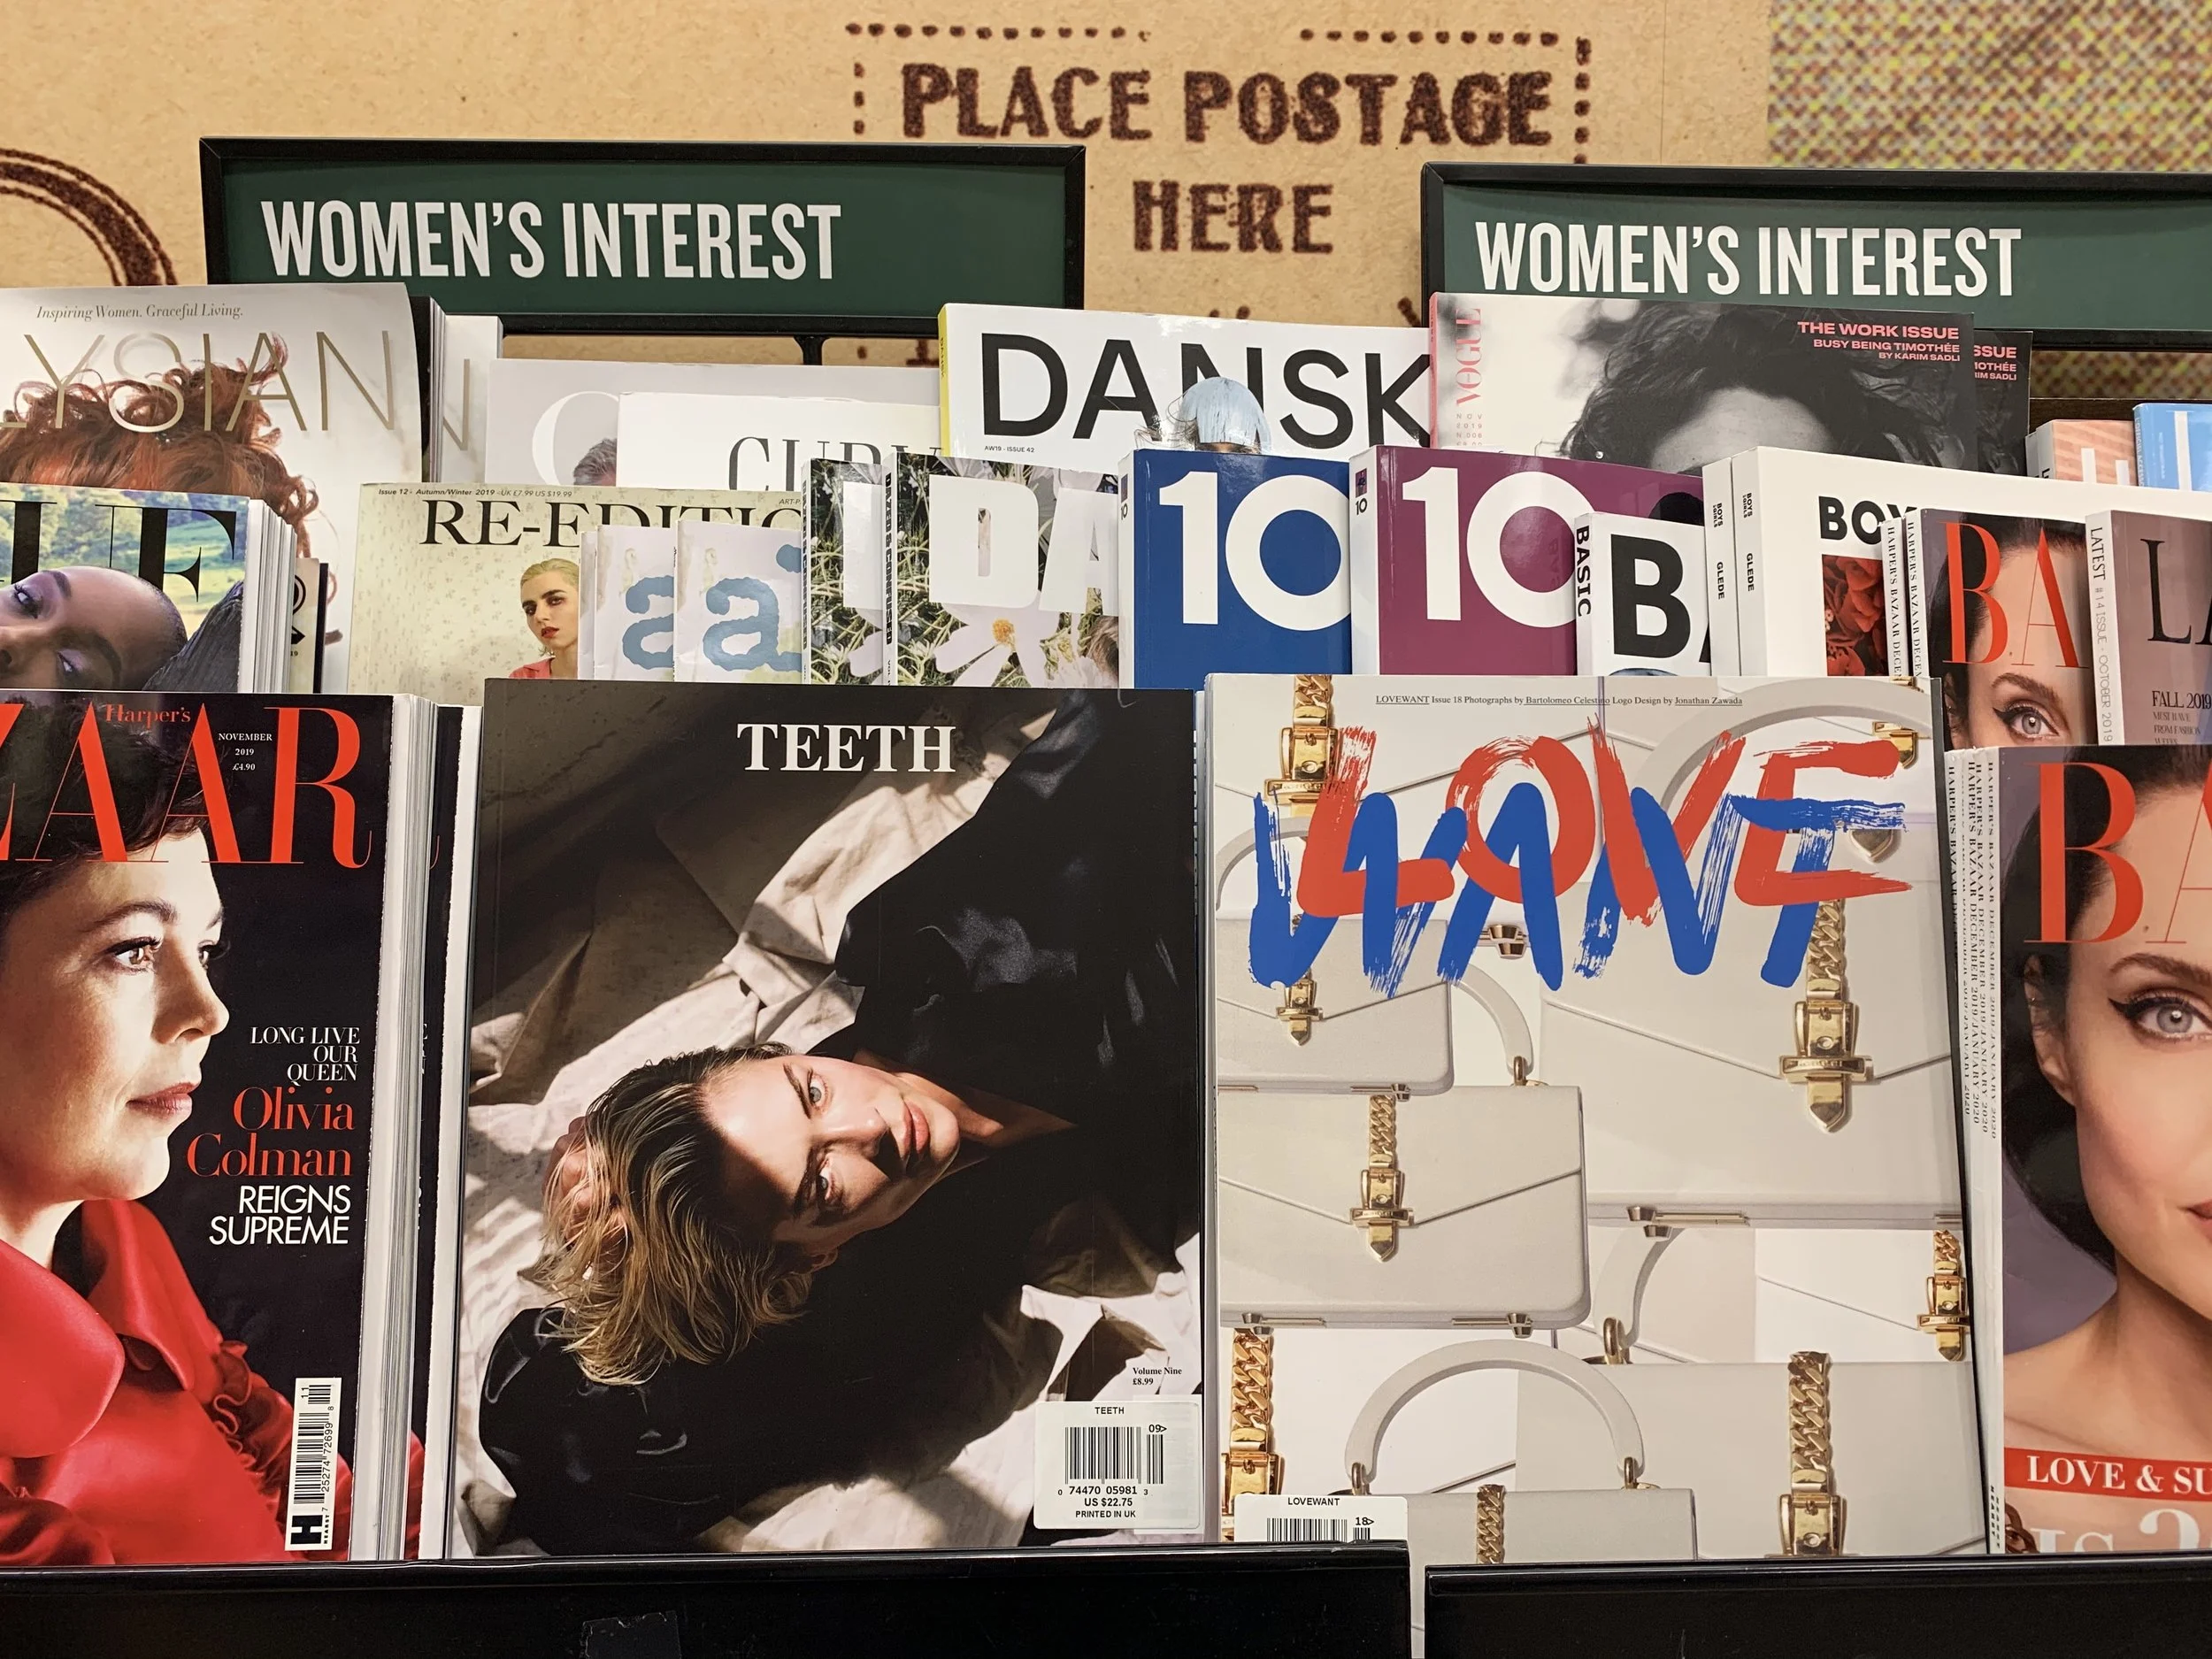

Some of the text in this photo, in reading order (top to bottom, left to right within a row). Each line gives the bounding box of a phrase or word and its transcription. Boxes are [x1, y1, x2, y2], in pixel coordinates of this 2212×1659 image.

[902, 63, 1553, 146] PLACE POSTAGE
[1133, 180, 1333, 254] HERE
[261, 200, 841, 280] WOMEN'S INTEREST
[1475, 221, 2022, 297] WOMEN'S INTEREST
[36, 303, 243, 321] Inspiring Women. Graceful Living.
[1797, 321, 1959, 340] THE WORK ISSUE
[1814, 339, 1960, 353] BUSY BEING TIMOTHÉE
[1455, 308, 1481, 406] VOGUE
[981, 333, 1431, 449] DANSK
[1355, 498, 1368, 515] 10
[1159, 471, 1351, 631] 10
[1402, 466, 1594, 628] 10
[1907, 522, 1917, 581] HARPER'S
[2091, 526, 2106, 580] LATEST
[1575, 525, 1592, 618] BASIC
[1610, 534, 1711, 664] B
[1887, 526, 1902, 677] HARPER'S BAZAAR DECE
[1910, 585, 1920, 634] BAZAAR
[2096, 612, 2108, 644] ISSUE
[2098, 656, 2111, 709] OCTOBER
[104, 704, 191, 728] Harper's
[1376, 695, 1430, 704] LOVEWANT
[1464, 695, 1513, 705] Photographs
[1514, 696, 1524, 705] by
[1574, 696, 1610, 705] Celestino
[1612, 696, 1632, 705] Logo
[1634, 697, 1662, 706] Design
[2152, 690, 2212, 710] FALL 2019
[219, 733, 273, 741] NOVEMBER
[2101, 713, 2113, 742] 2019
[234, 748, 255, 757] 2019
[736, 723, 956, 773] TEETH
[232, 763, 256, 772] £4.90
[0, 701, 372, 868] AAR
[250, 1026, 360, 1044] LONG LIVE
[313, 1045, 358, 1063] OUR
[287, 1064, 357, 1087] QUEEN
[233, 1086, 354, 1131] Olivia
[187, 1133, 353, 1178] Colman
[239, 1184, 350, 1215] REIGNS
[209, 1216, 349, 1245] SUPREME
[323, 1422, 334, 1455] 72699
[321, 1461, 331, 1493] 25274
[2027, 1455, 2125, 1490] LOVE
[2136, 1465, 2164, 1493] &
[1069, 1486, 1101, 1495] 74470
[1106, 1486, 1138, 1495] 05981
[1084, 1497, 1133, 1508] US $22.75
[1287, 1497, 1340, 1506] LOVEWANT
